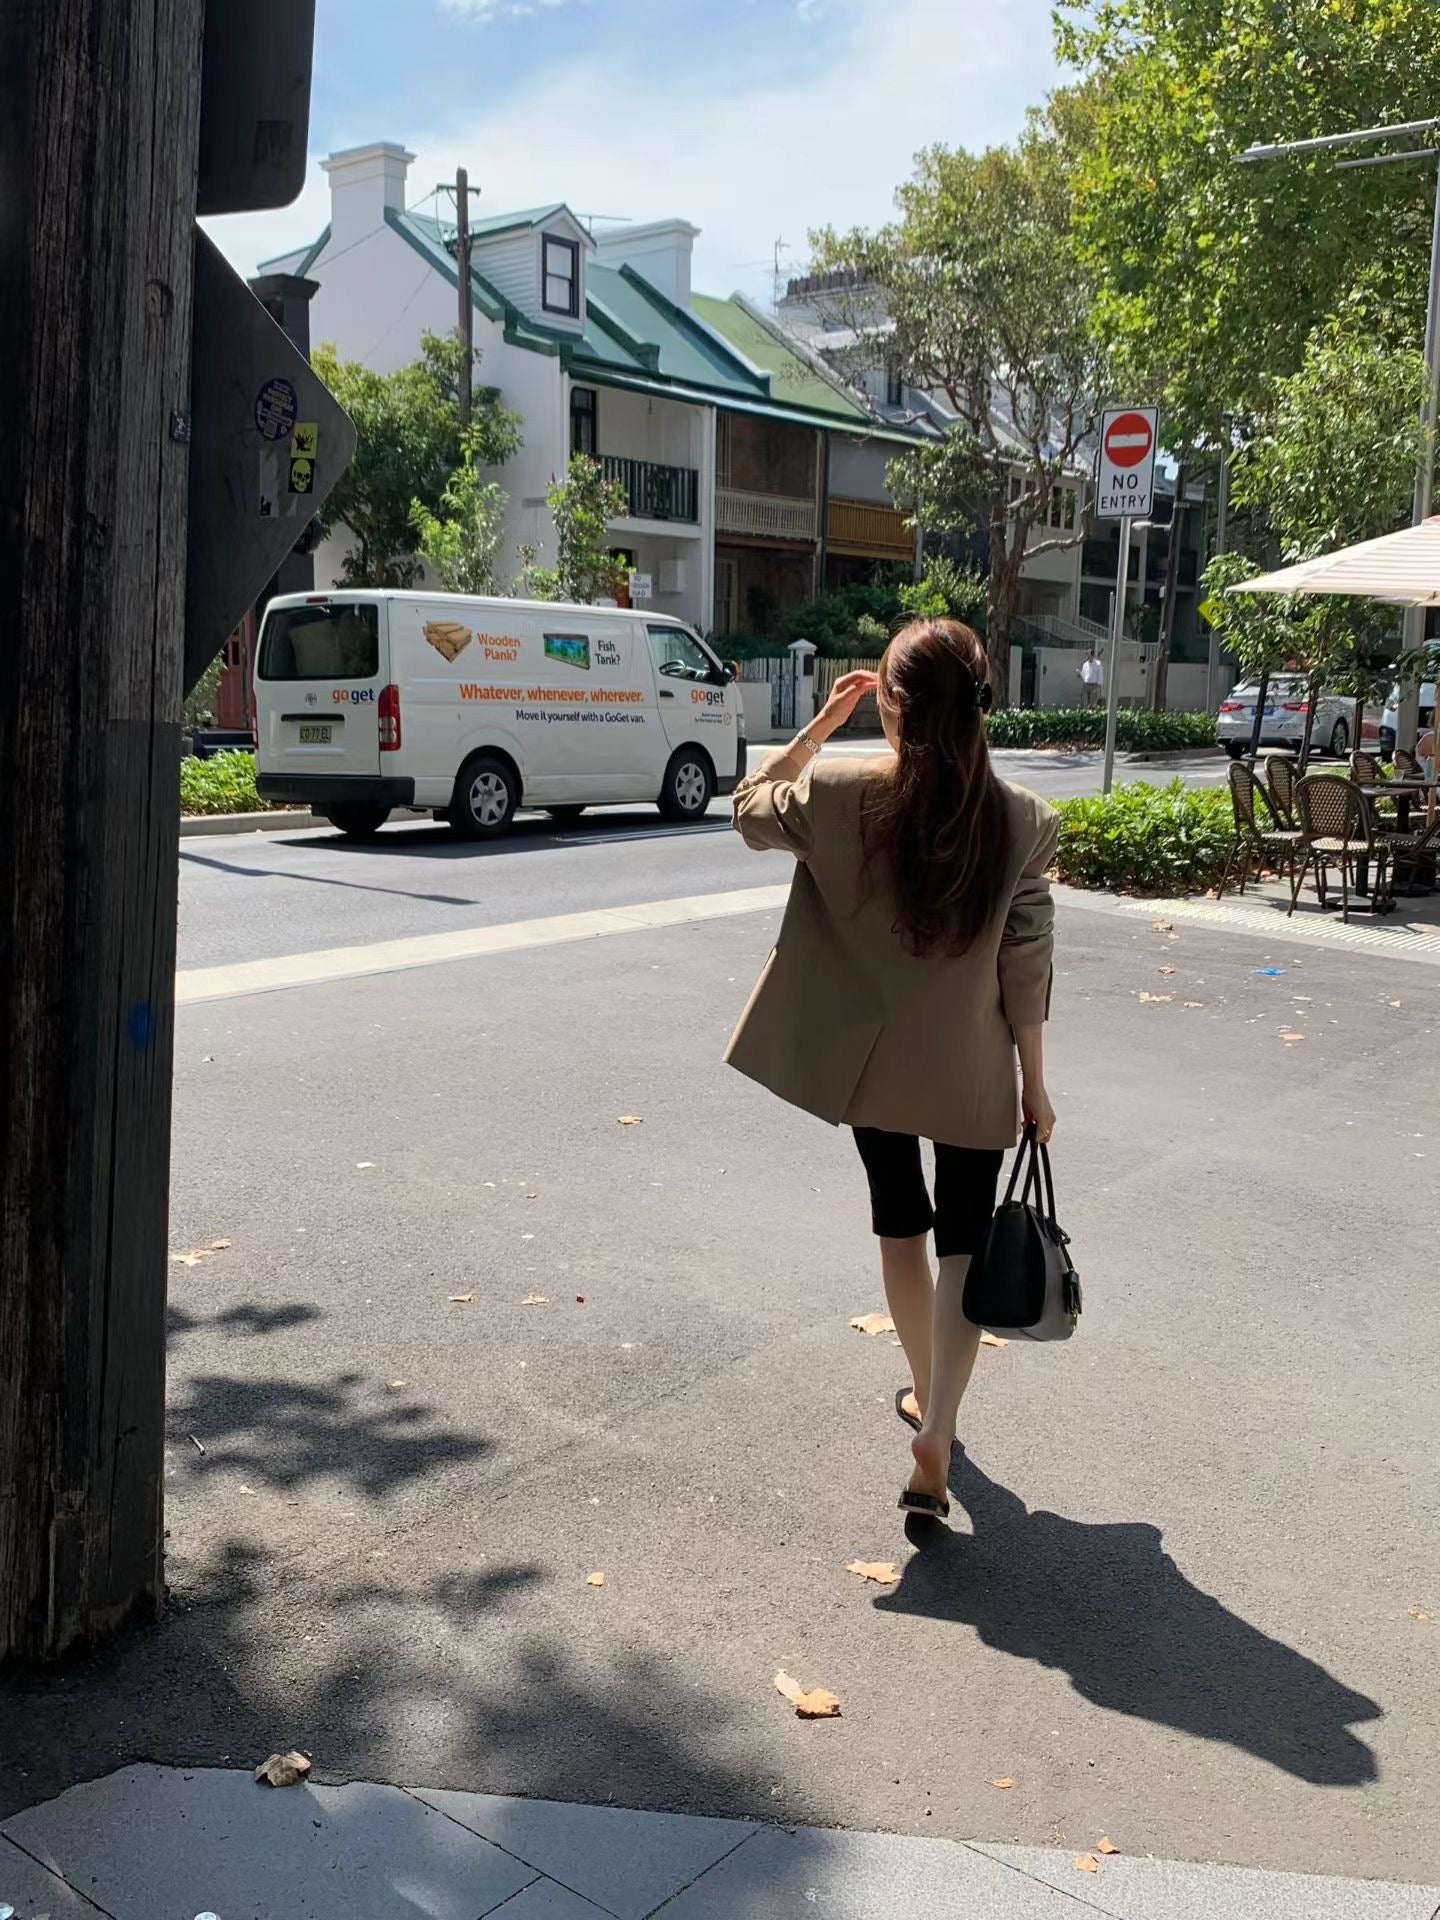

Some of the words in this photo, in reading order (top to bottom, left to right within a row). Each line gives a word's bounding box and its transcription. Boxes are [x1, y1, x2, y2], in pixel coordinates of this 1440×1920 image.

[1112, 473, 1138, 490] NO
[1101, 494, 1147, 510] ENTRY
[477, 632, 521, 648] Wooden
[597, 639, 616, 652] Fish
[485, 648, 517, 661] Plank?
[594, 653, 621, 665] Tank?
[459, 683, 525, 702] Whatever,
[527, 686, 588, 703] whenever,
[590, 687, 645, 703] wherever.
[516, 709, 539, 720] Move
[540, 710, 546, 720] it
[547, 711, 580, 724] yourself
[581, 711, 597, 722] with
[599, 714, 604, 722] a
[605, 712, 630, 723] GoGet
[631, 715, 646, 723] van.
